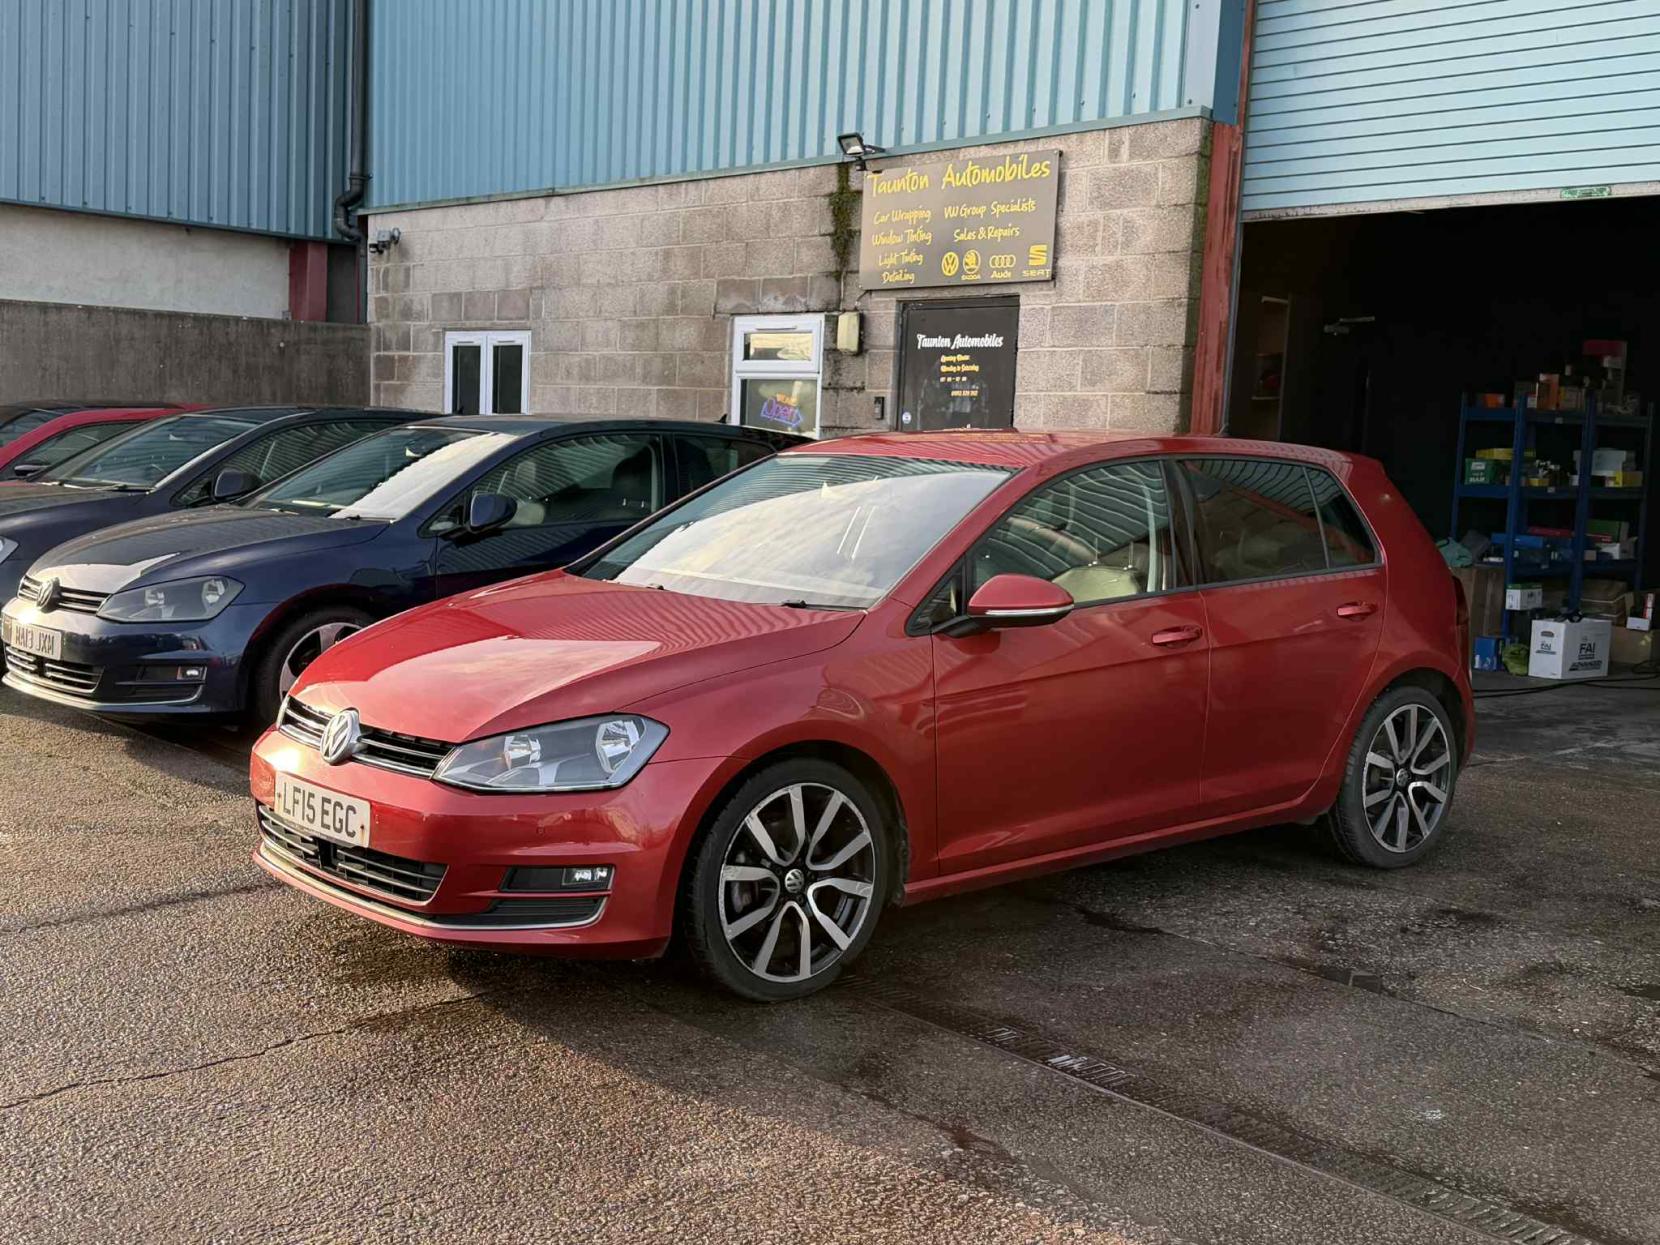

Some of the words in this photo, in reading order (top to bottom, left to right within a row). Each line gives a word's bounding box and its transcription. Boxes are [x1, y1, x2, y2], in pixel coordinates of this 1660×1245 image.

[868, 169, 929, 197] Taunton
[941, 154, 1051, 190] Automobiles
[873, 211, 890, 225] Car
[892, 205, 932, 225] Wrapping
[960, 204, 987, 219] Group
[991, 198, 1037, 216] Specialists
[872, 229, 903, 246] Window
[904, 225, 932, 245] Tinting
[954, 229, 977, 243] Sales
[878, 252, 899, 269] Light
[882, 268, 915, 284] Detailing
[990, 270, 1012, 279] Audi
[1022, 269, 1051, 278] SEAT
[916, 333, 950, 349] Taunton
[951, 333, 1004, 349] Automobiles
[282, 782, 316, 824] LF15
[320, 796, 357, 838] EGC
